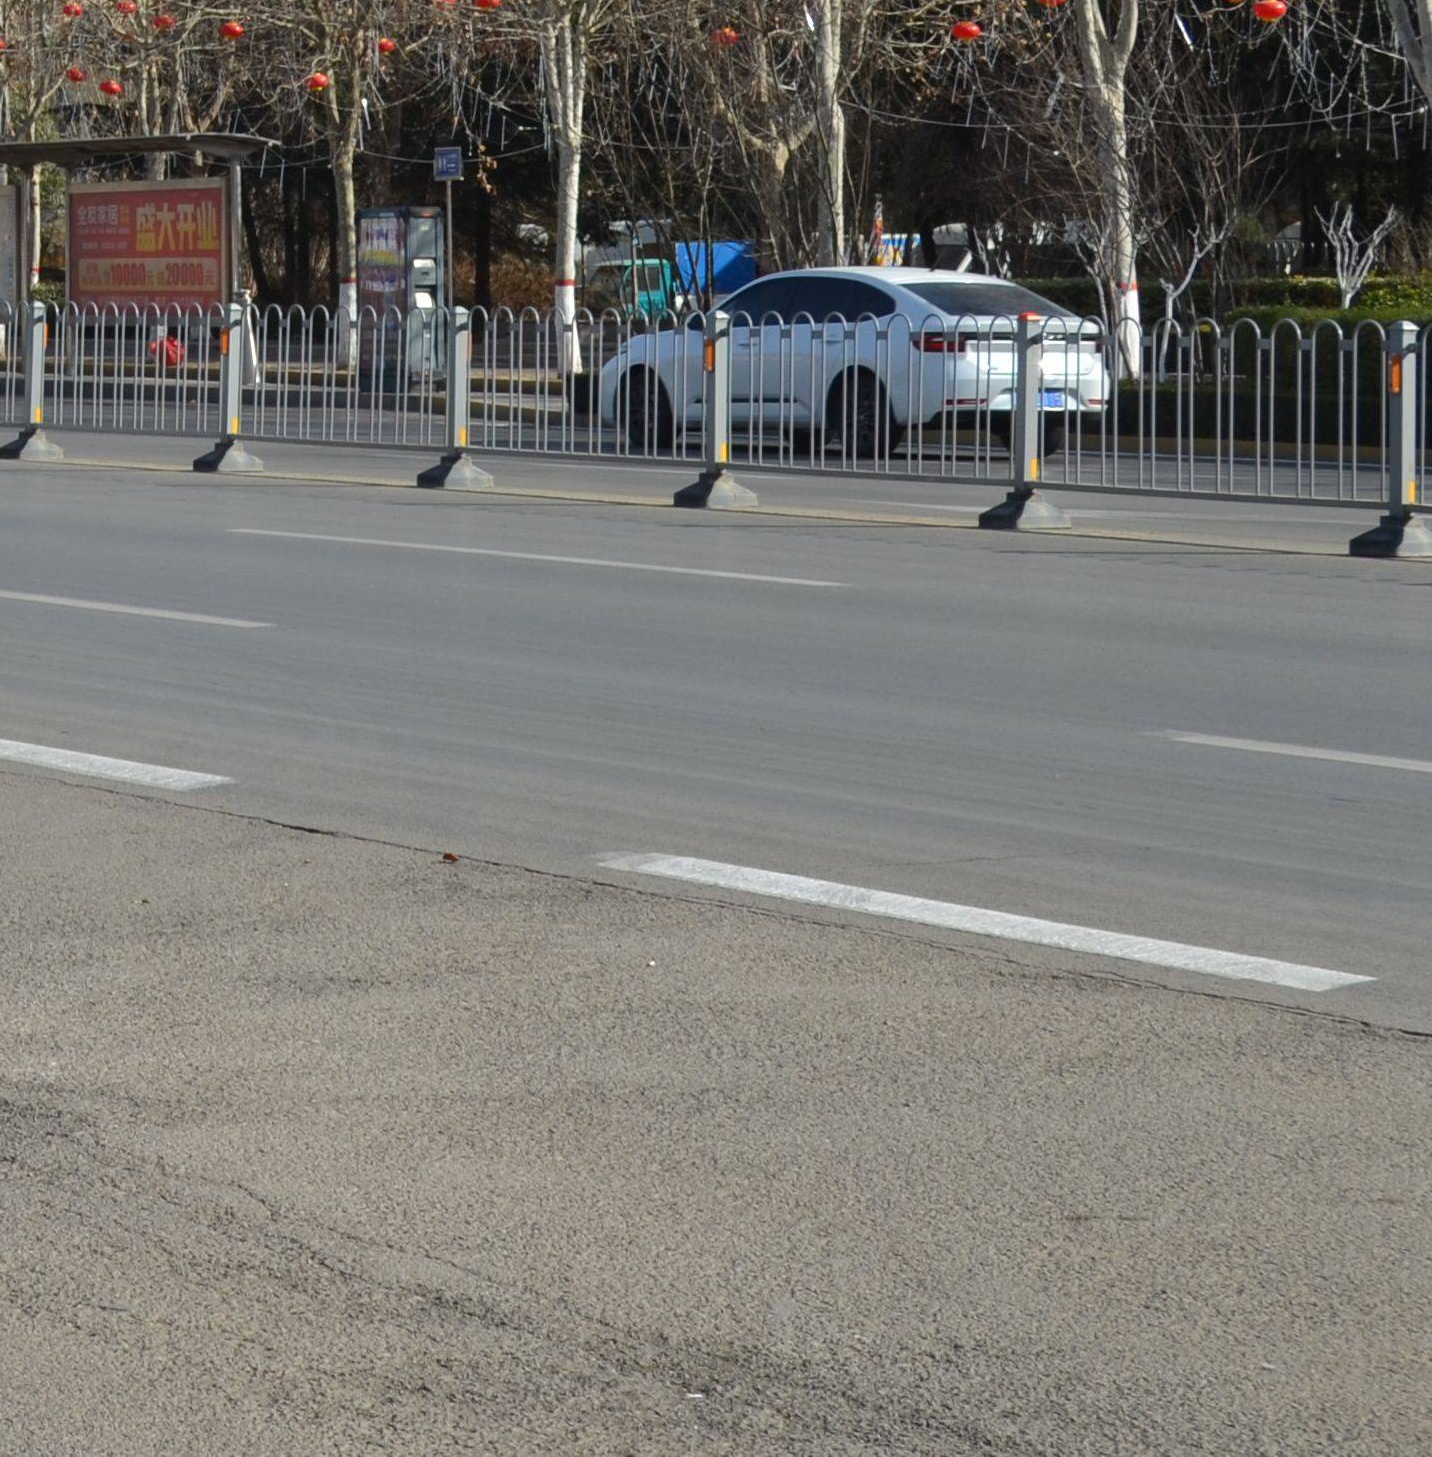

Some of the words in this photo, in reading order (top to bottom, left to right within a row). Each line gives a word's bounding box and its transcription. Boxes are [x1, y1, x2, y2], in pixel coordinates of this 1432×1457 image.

[77, 204, 118, 225] 全友家居
[136, 201, 219, 251] 盛大开业
